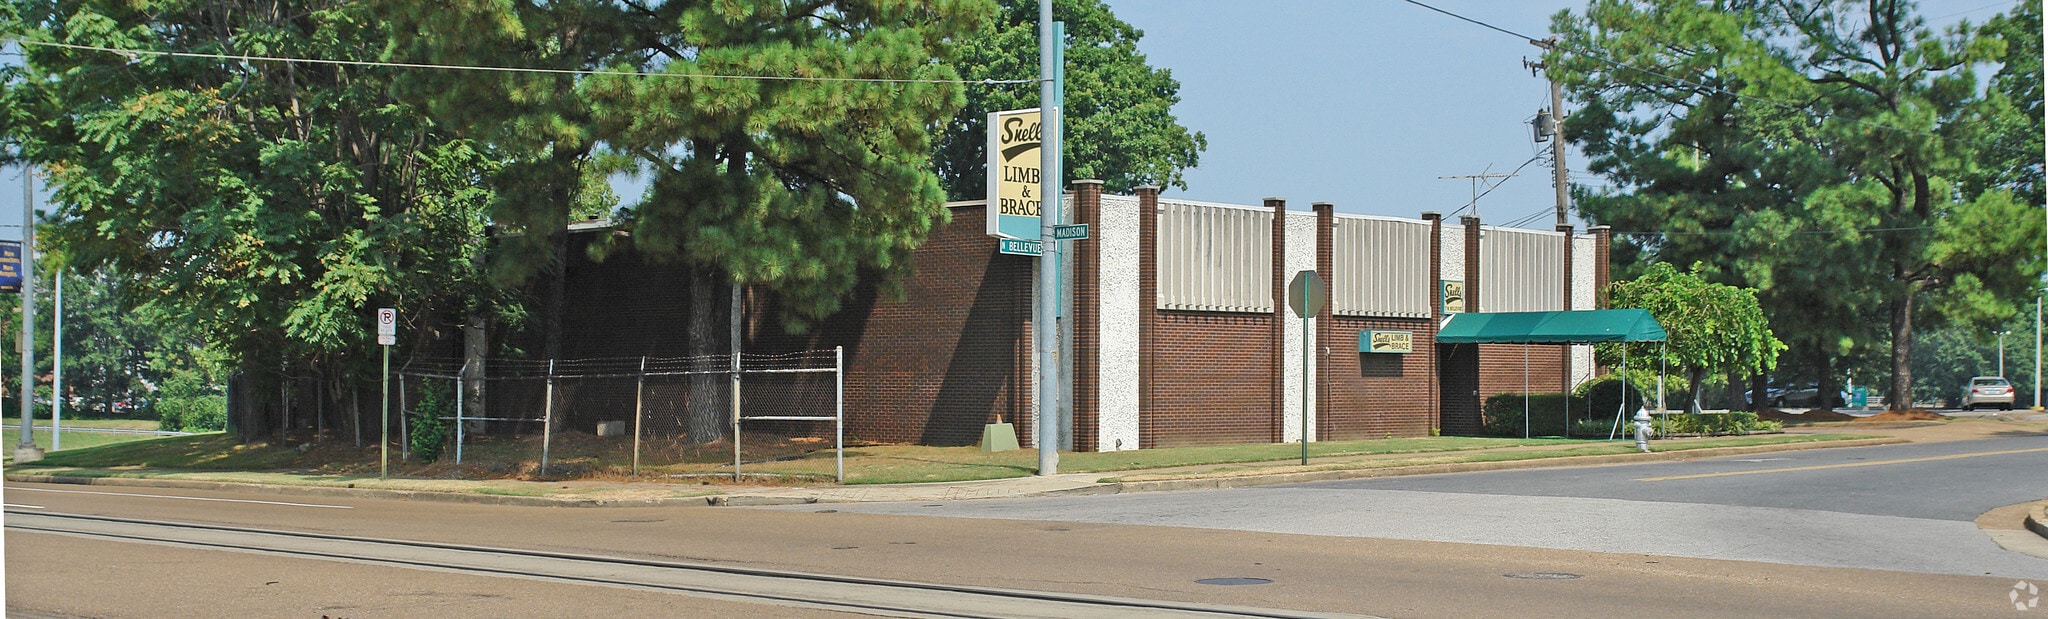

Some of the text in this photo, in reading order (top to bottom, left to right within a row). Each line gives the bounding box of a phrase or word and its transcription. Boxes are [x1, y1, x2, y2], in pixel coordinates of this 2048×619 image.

[1004, 165, 1040, 184] LIMB
[1021, 185, 1031, 198] &
[1056, 226, 1086, 238] MADISON
[1009, 241, 1042, 253] BELLEVUE
